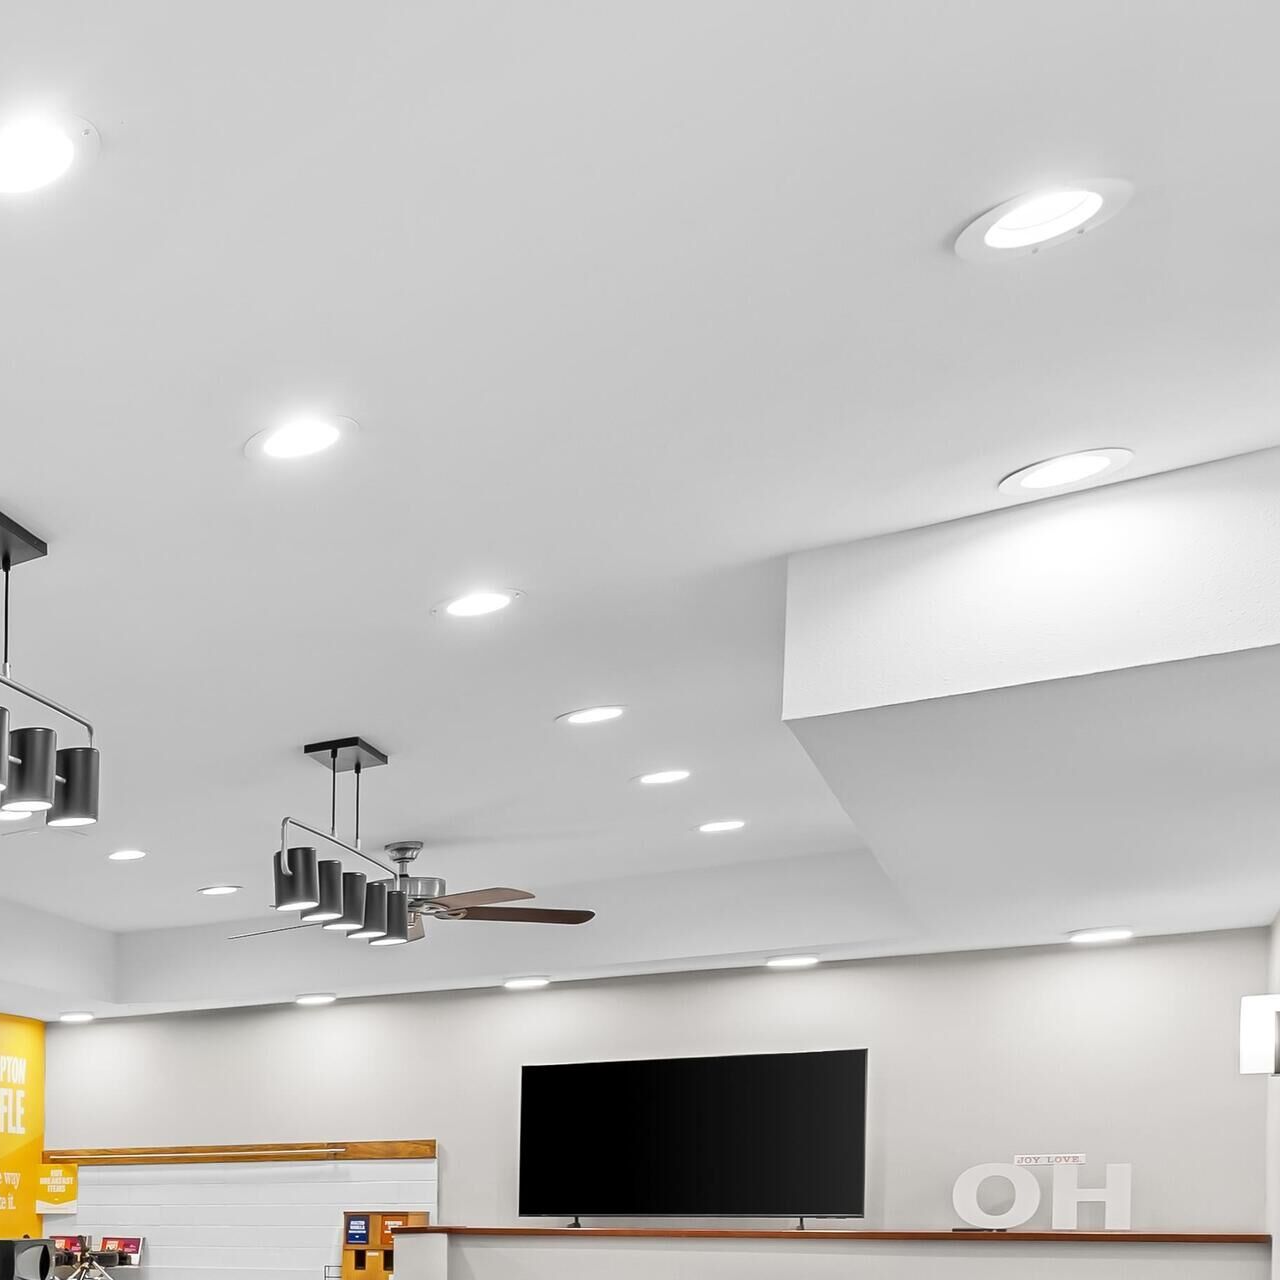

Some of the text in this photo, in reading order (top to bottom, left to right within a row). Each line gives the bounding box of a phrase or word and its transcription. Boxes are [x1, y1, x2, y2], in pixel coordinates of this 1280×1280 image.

[1016, 1156, 1040, 1164] JOY
[4, 1172, 21, 1190] way
[7, 1193, 17, 1210] it.
[952, 1162, 1132, 1230] OH
